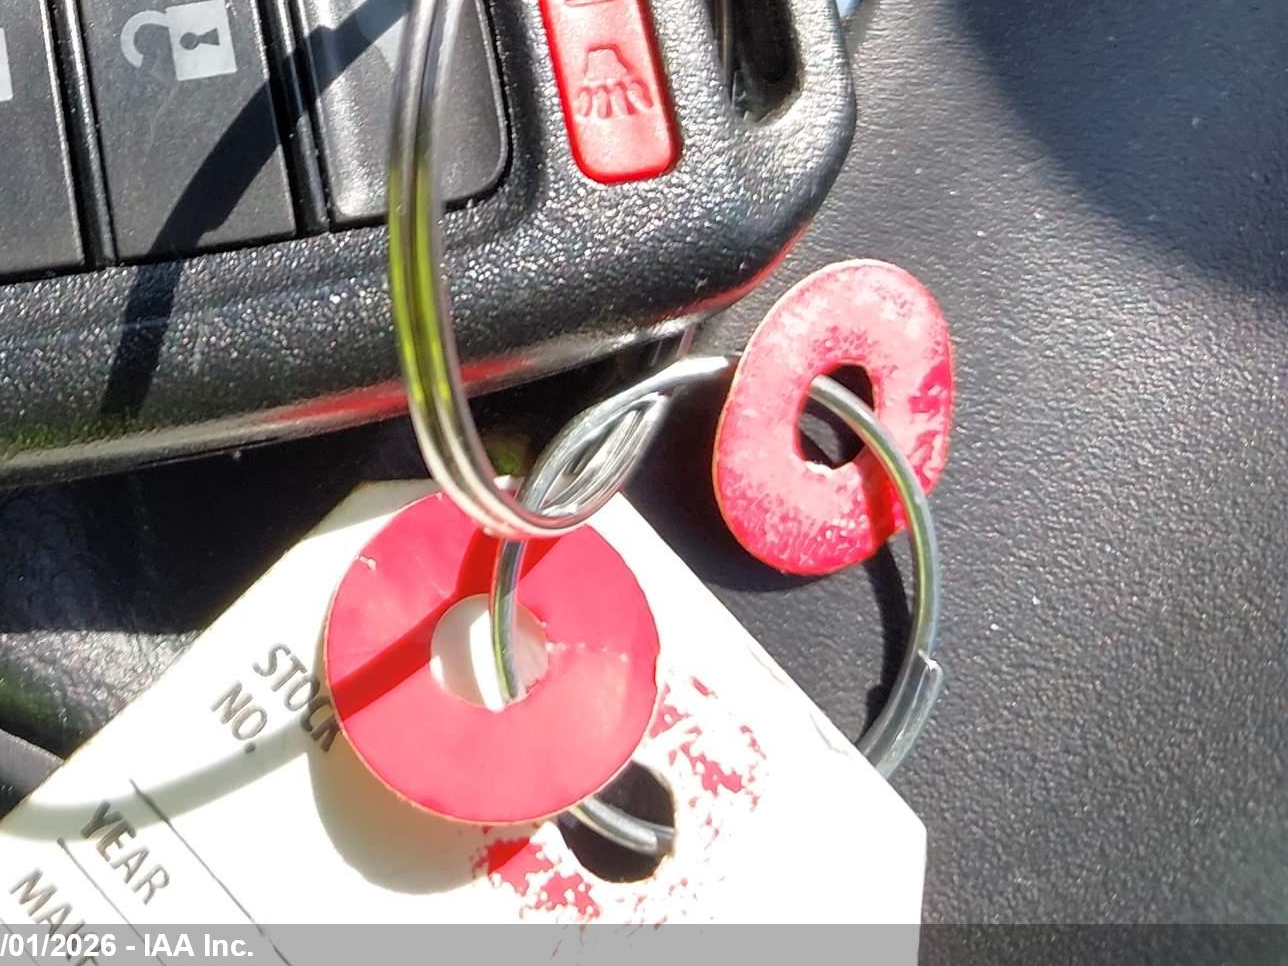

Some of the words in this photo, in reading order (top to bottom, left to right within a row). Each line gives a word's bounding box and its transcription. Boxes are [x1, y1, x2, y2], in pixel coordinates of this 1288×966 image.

[210, 679, 268, 754] NO.
[251, 642, 344, 753] STOCK
[80, 799, 170, 905] YEAR
